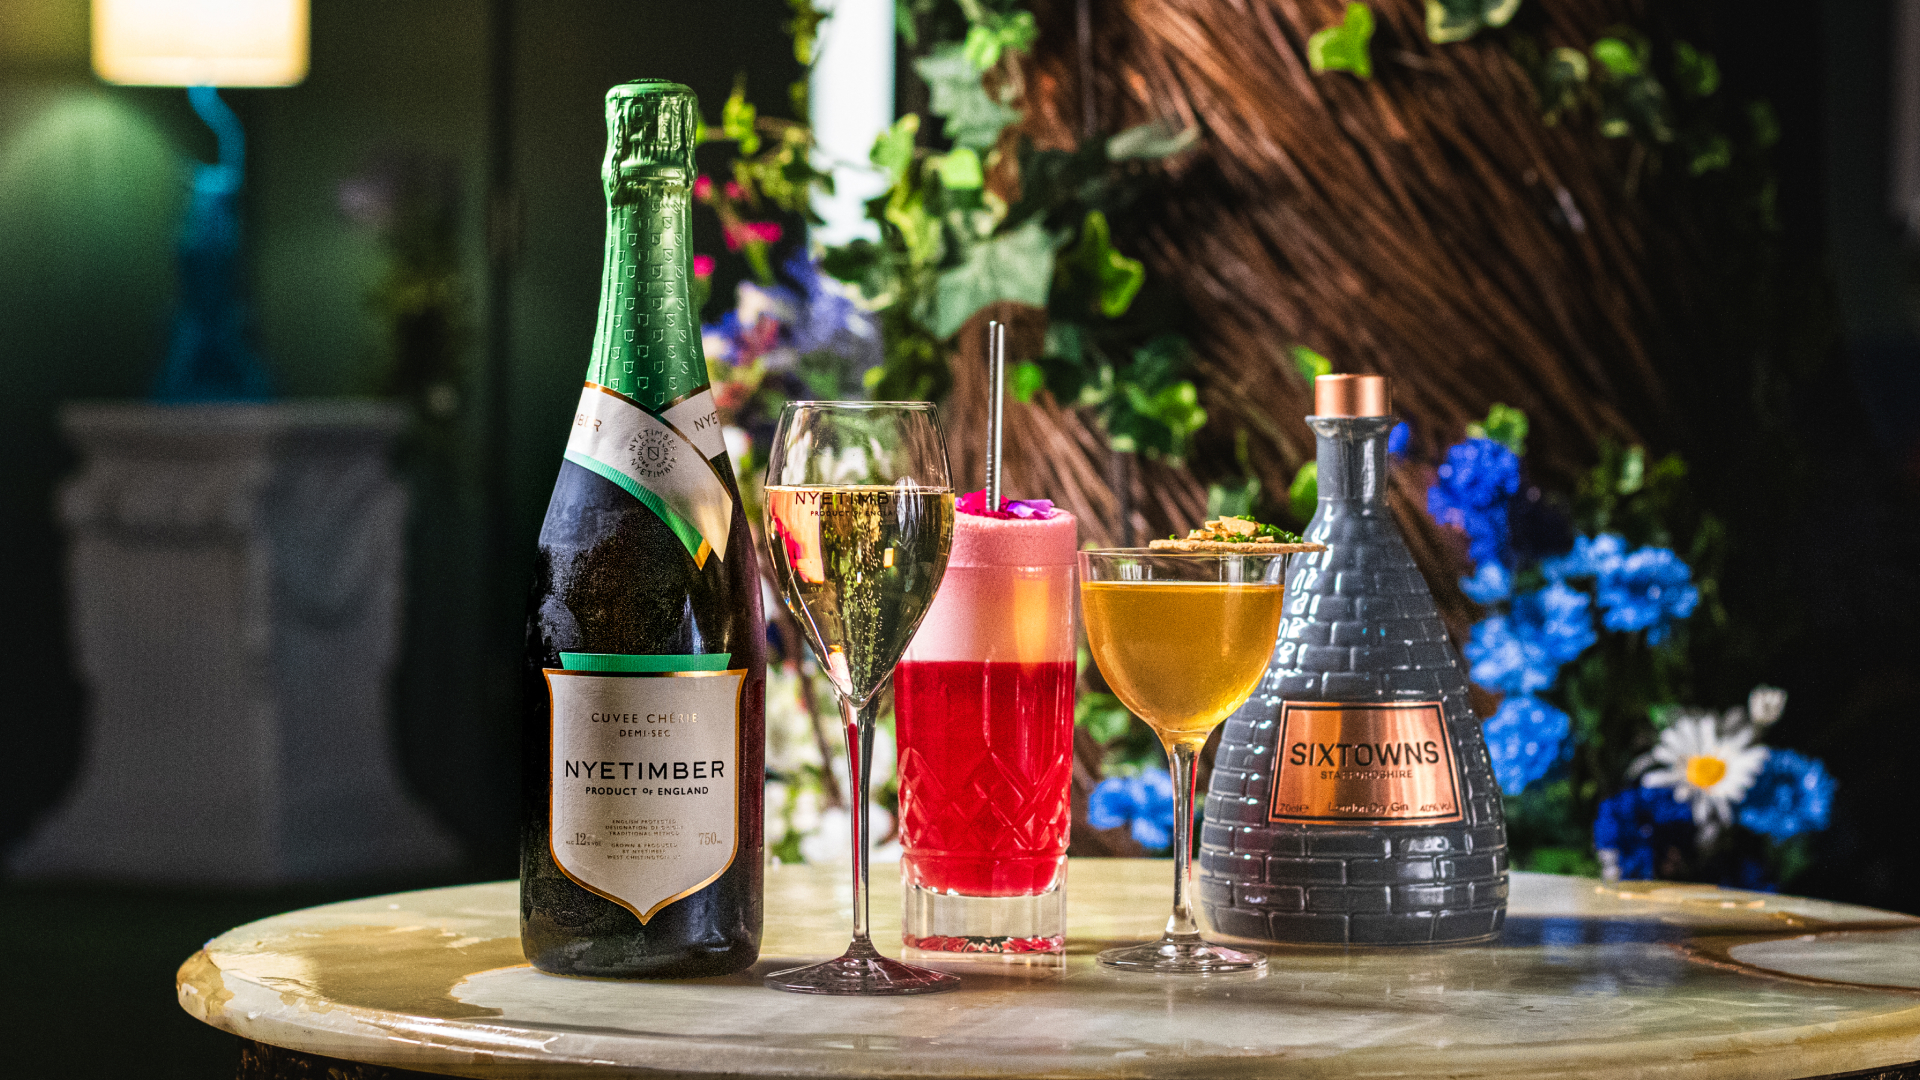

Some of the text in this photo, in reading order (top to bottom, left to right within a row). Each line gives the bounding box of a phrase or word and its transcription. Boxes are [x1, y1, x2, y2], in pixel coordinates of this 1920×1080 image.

[693, 410, 718, 431] NYE
[795, 491, 917, 505] NYETIMB
[591, 713, 638, 724] CUVEE
[1290, 741, 1440, 767] SIXTOWNS
[565, 760, 725, 780] NYETIMBER
[585, 786, 638, 796] PRODUCT
[657, 786, 709, 796] ENGLAND
